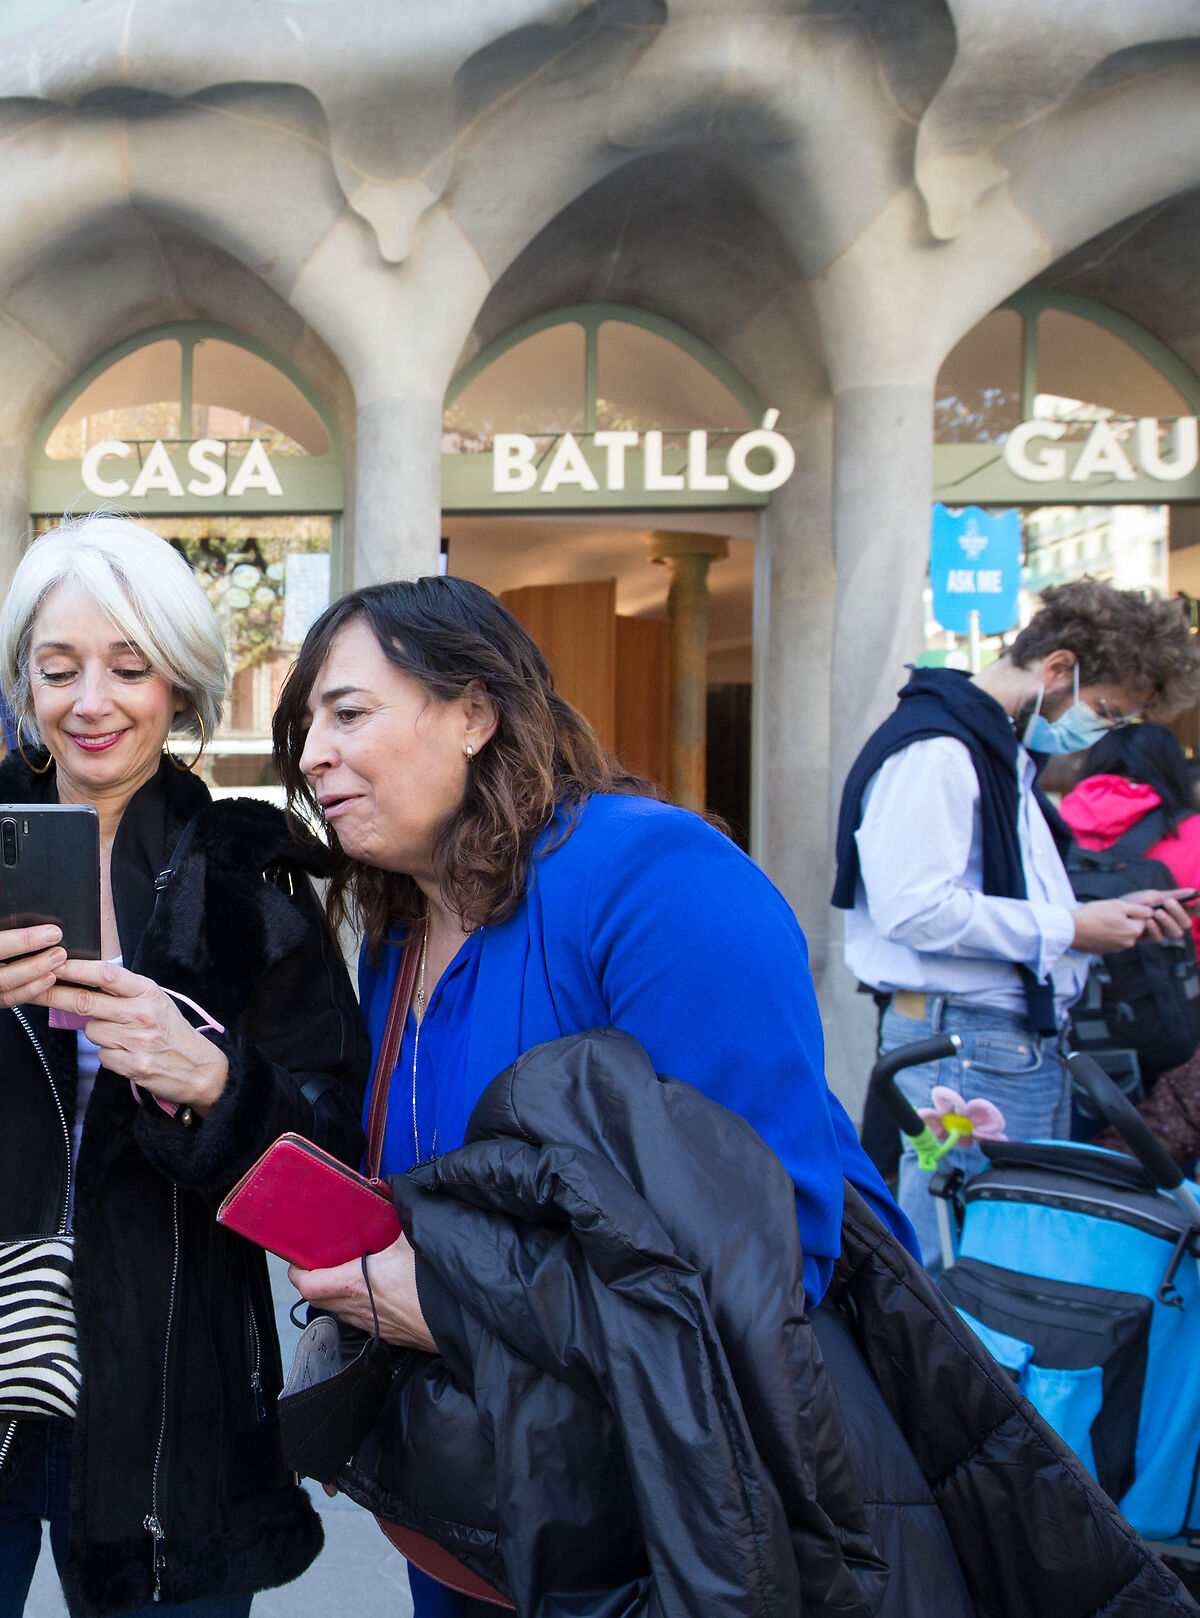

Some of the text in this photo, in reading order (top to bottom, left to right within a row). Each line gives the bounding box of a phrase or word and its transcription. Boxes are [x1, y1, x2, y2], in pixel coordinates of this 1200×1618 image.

[80, 407, 1198, 497] CASA BATLLÓ GAU
[946, 568, 1003, 594] ASK ME
